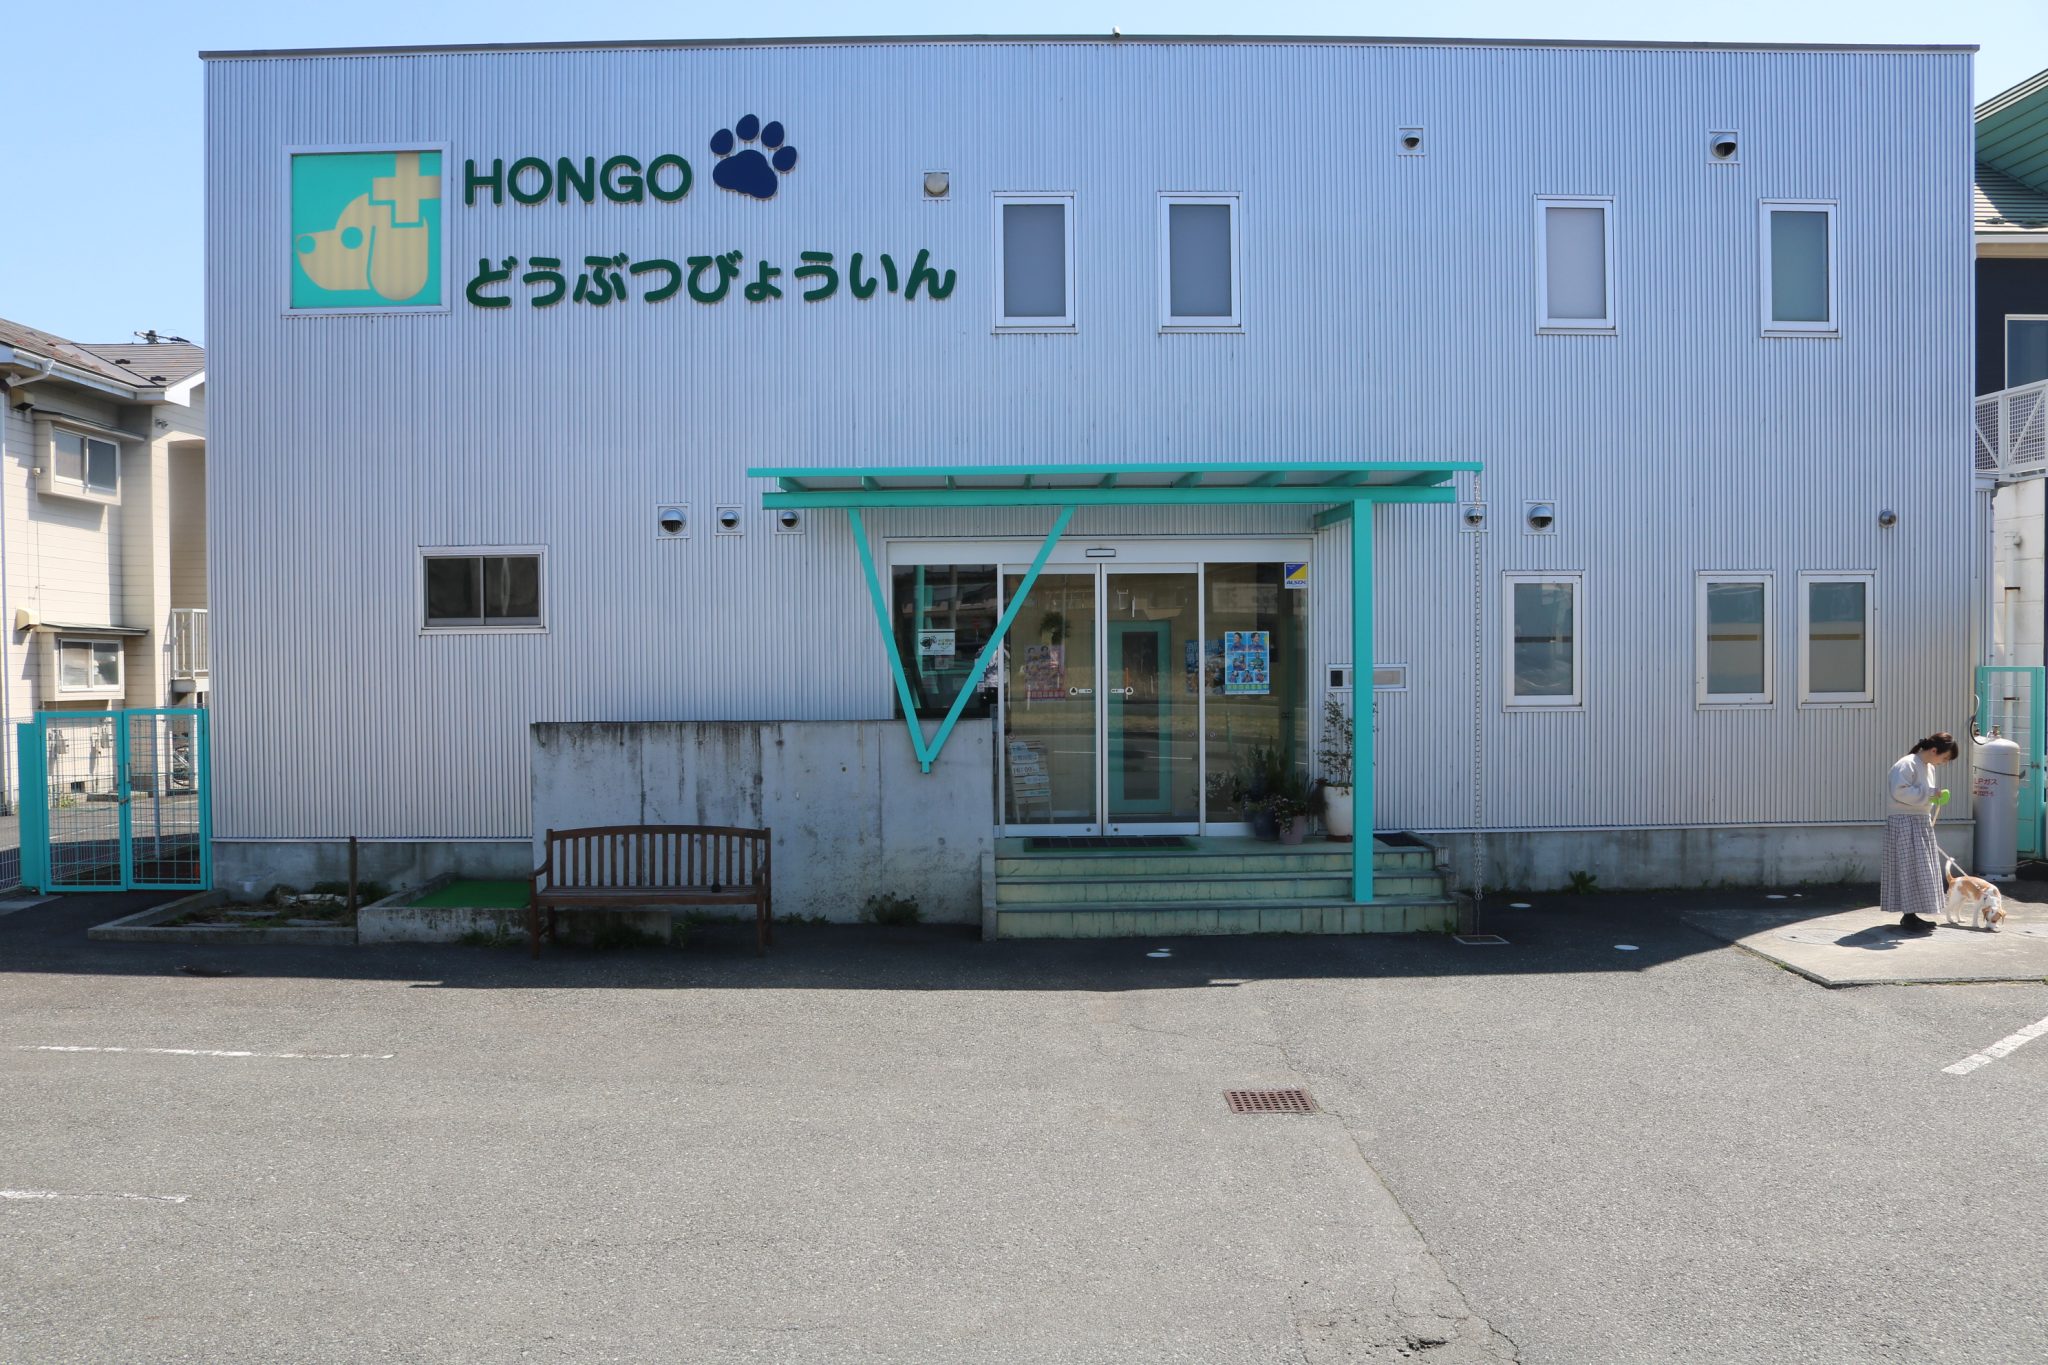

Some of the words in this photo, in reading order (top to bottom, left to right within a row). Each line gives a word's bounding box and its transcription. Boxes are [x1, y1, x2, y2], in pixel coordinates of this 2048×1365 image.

[464, 153, 693, 206] HONGO
[465, 248, 957, 308] どうぶつびょういん
[1974, 777, 1999, 786] LPガス
